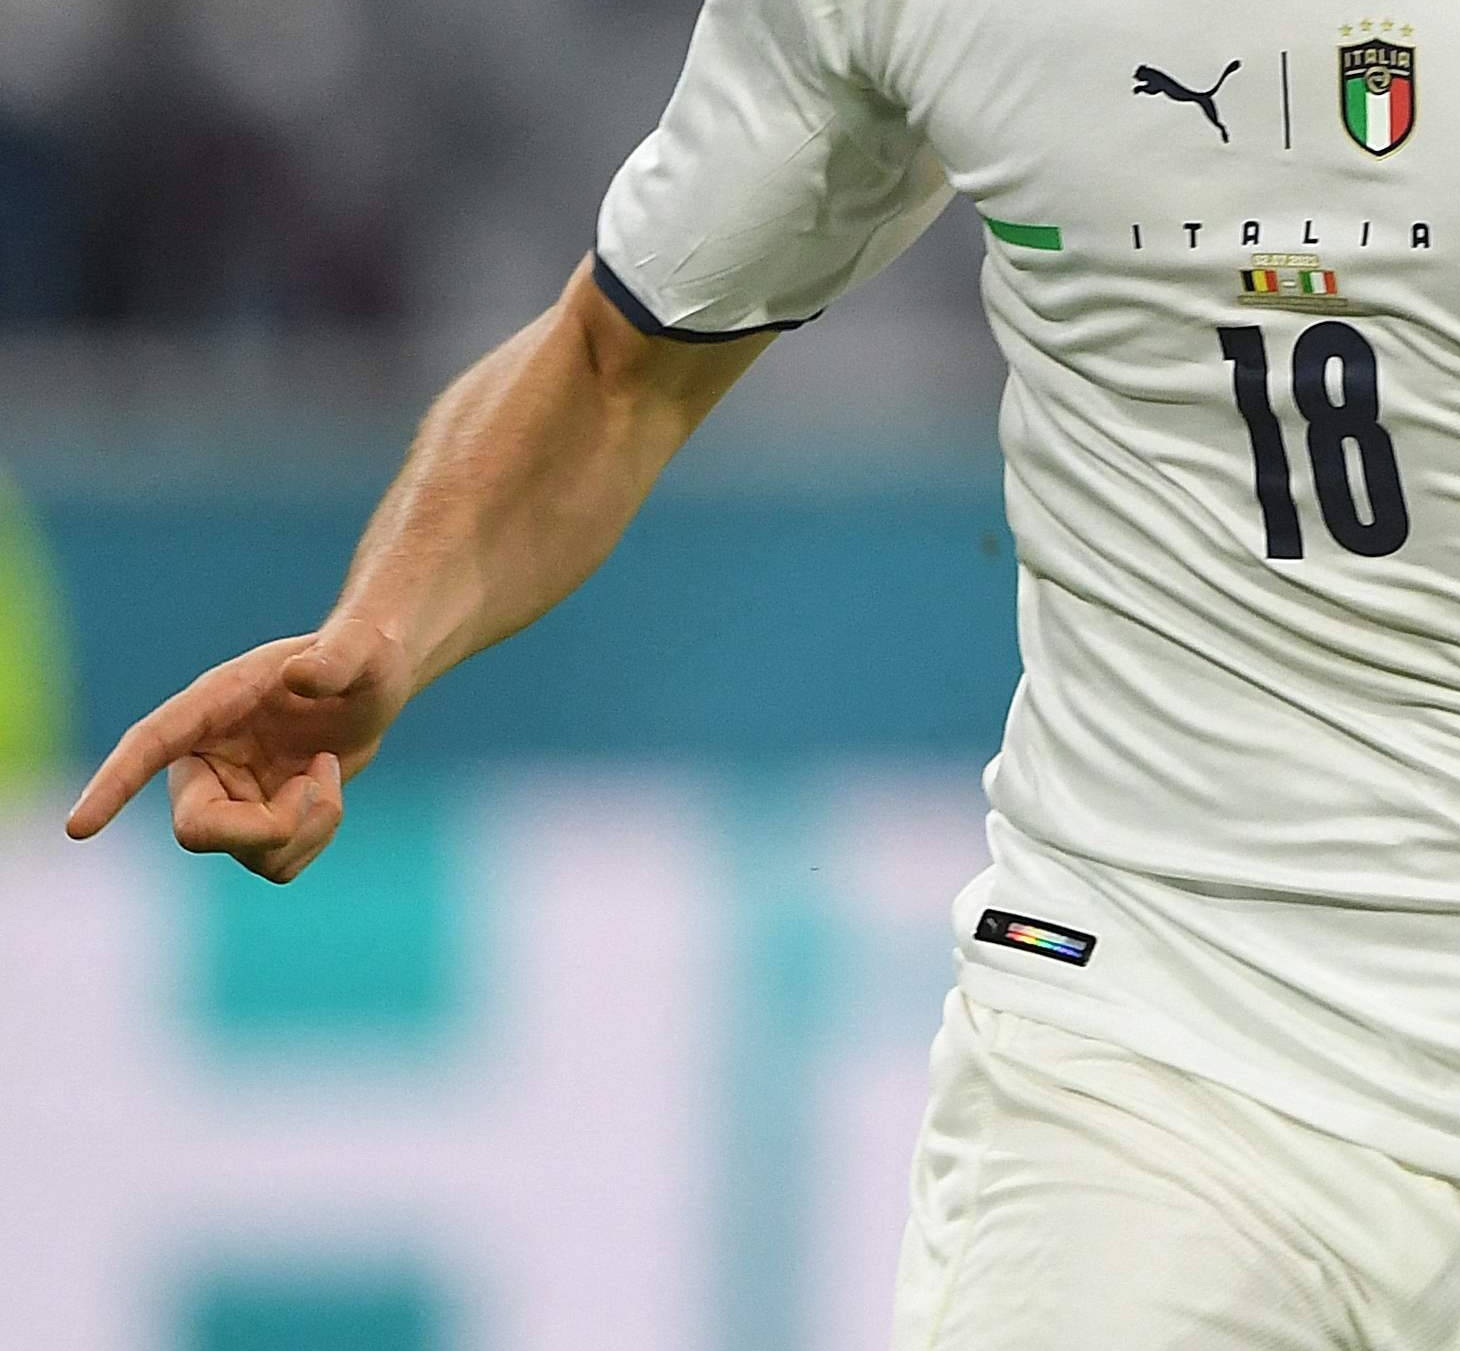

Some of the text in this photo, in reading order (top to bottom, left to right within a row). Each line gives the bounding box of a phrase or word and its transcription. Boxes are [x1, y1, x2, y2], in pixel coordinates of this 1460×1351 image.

[1343, 48, 1411, 68] ITALIA
[1131, 220, 1432, 250] ITALIA
[1216, 320, 1410, 560] 18
